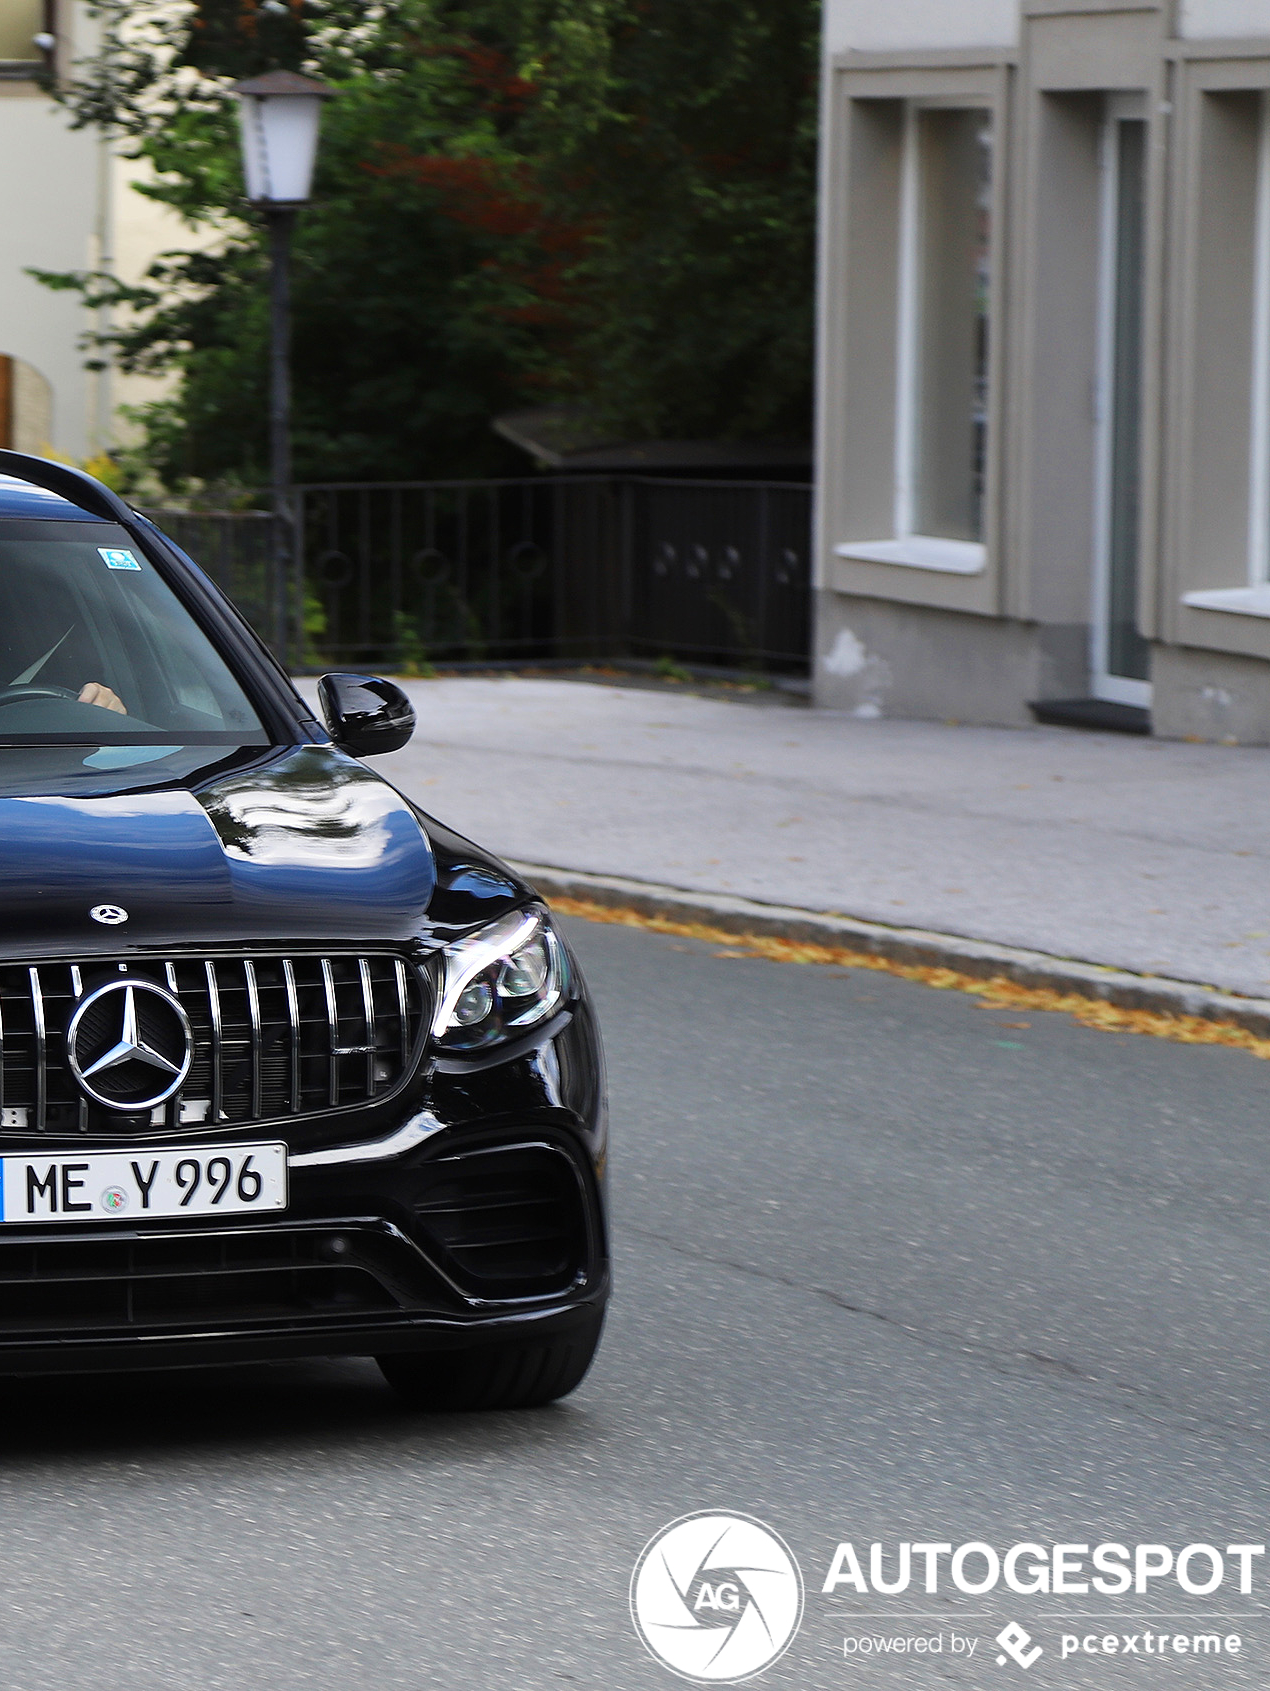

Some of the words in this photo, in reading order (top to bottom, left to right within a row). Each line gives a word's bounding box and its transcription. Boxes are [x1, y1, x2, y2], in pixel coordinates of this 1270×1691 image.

[26, 1163, 92, 1213] ME
[130, 1160, 160, 1209] Y
[175, 1154, 262, 1206] 996
